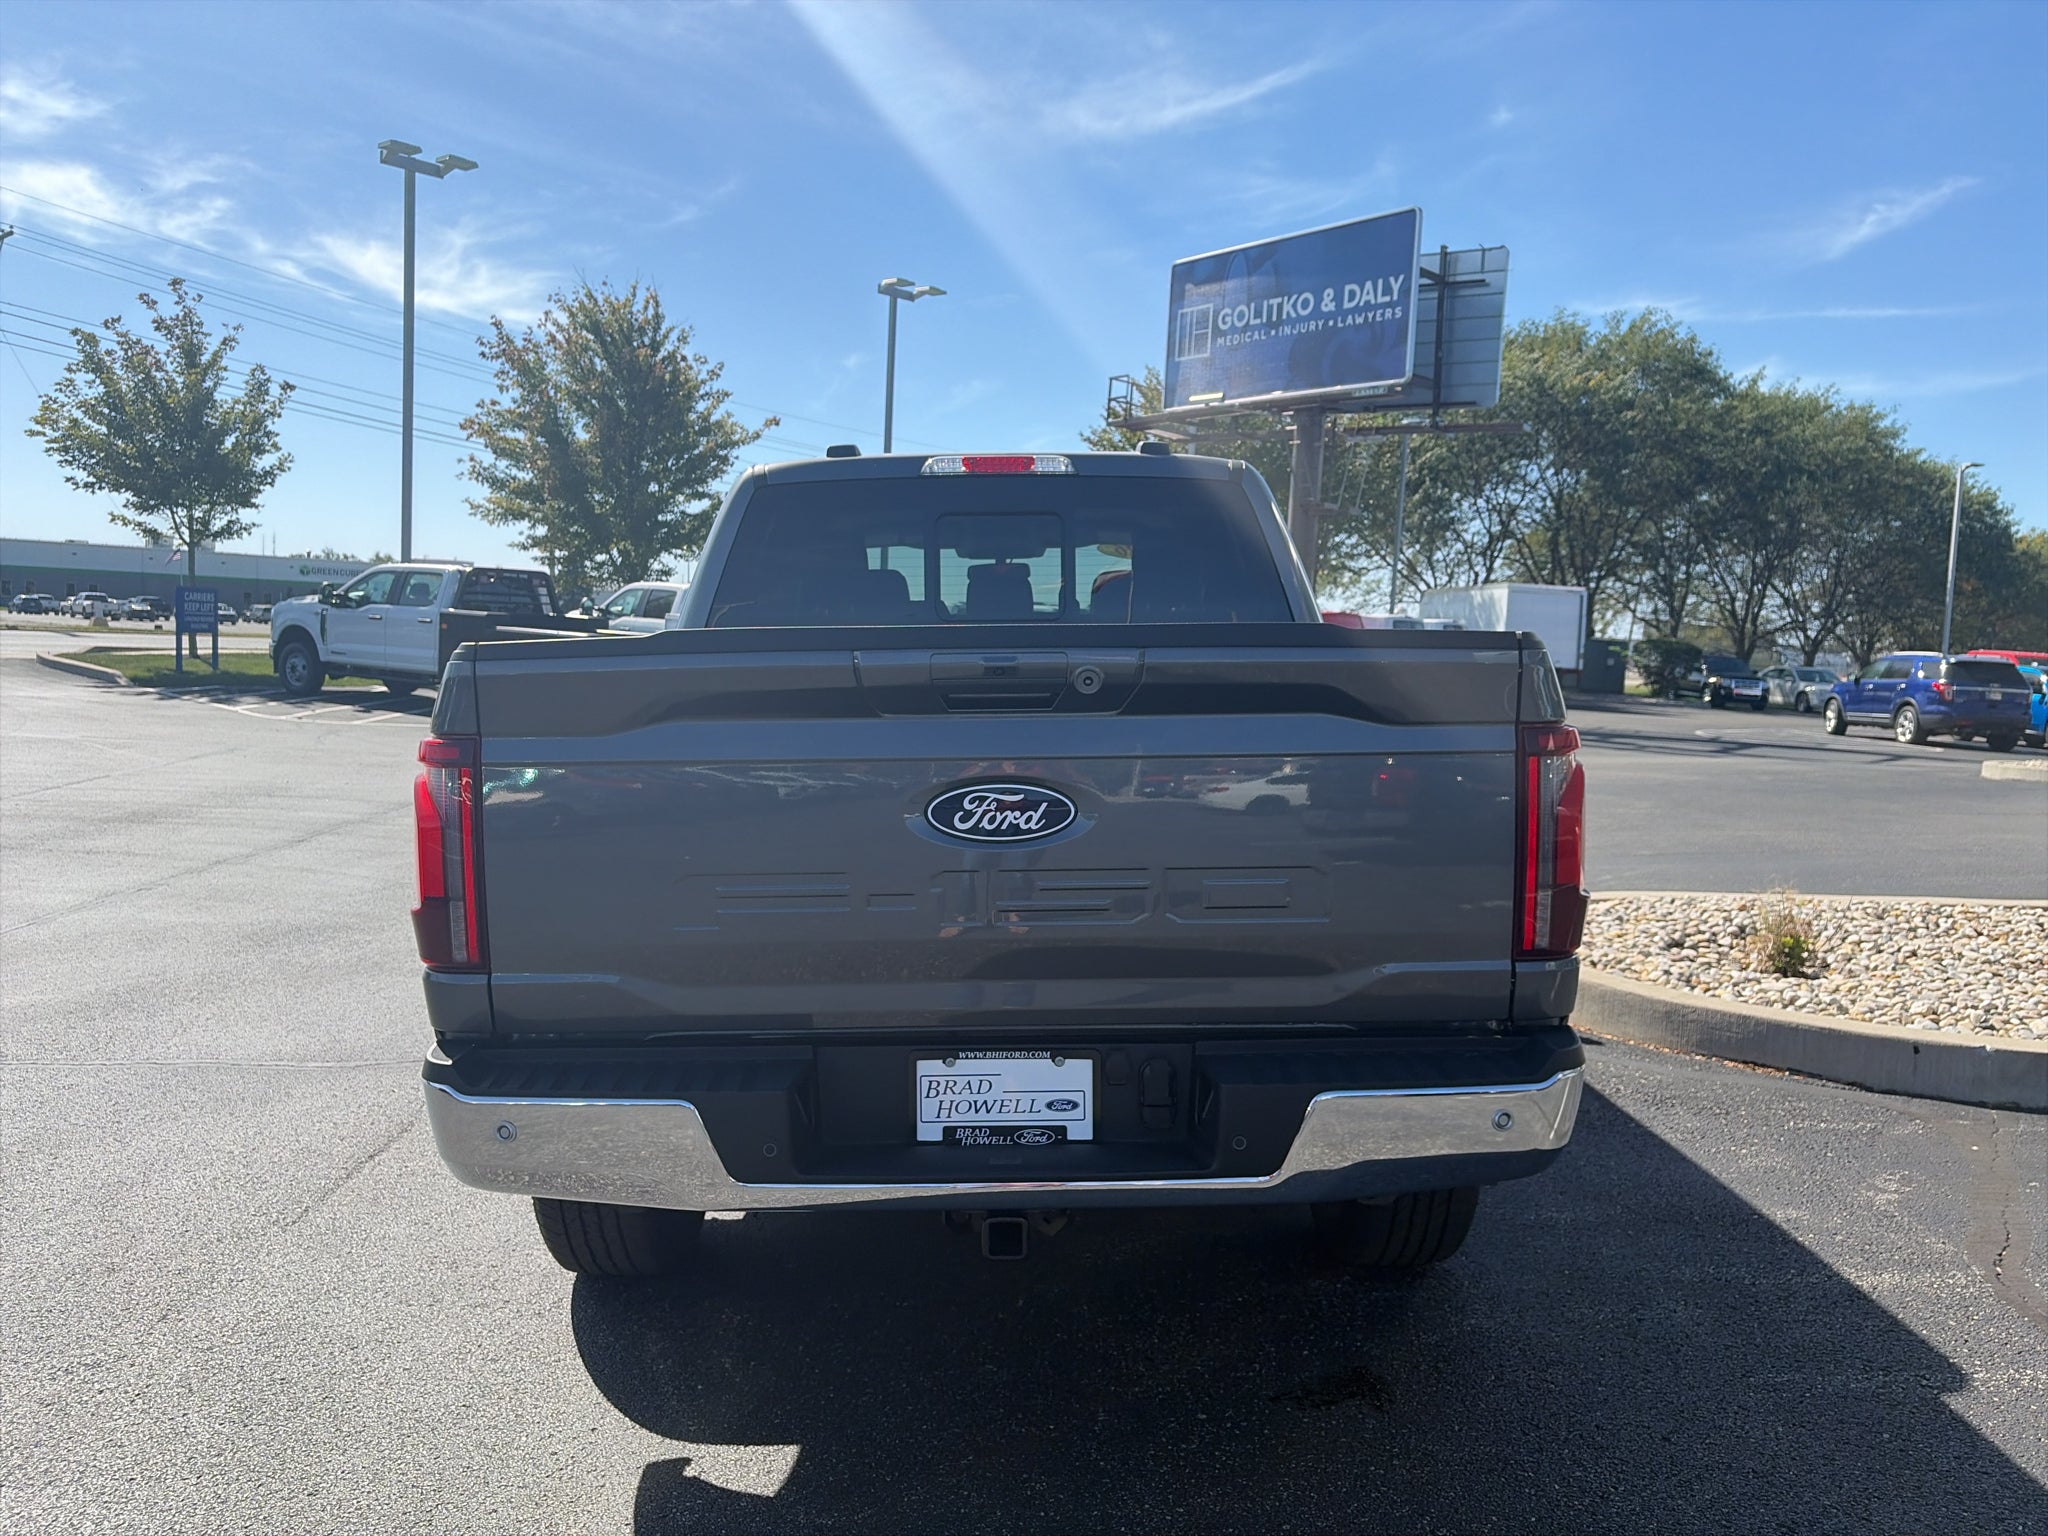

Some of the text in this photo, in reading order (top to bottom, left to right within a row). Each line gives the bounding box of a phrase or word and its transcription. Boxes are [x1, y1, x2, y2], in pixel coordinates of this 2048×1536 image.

[1217, 274, 1405, 330] GOLITKO & DALY
[1216, 307, 1402, 347] MEDICAL INJURY LAWYERS
[311, 567, 339, 577] GREEN
[184, 591, 216, 602] CARRIERS
[184, 601, 215, 612] KEEP LEFT
[953, 792, 1048, 830] Ford
[958, 1051, 1051, 1059] WWW.BHIFORD.COM
[924, 1079, 993, 1099] BRAD
[935, 1098, 1042, 1119] HOWELL
[1050, 1101, 1074, 1110] Ford
[955, 1128, 990, 1139] BRAD
[1020, 1131, 1049, 1143] Ford
[961, 1136, 1014, 1147] HOWELL
